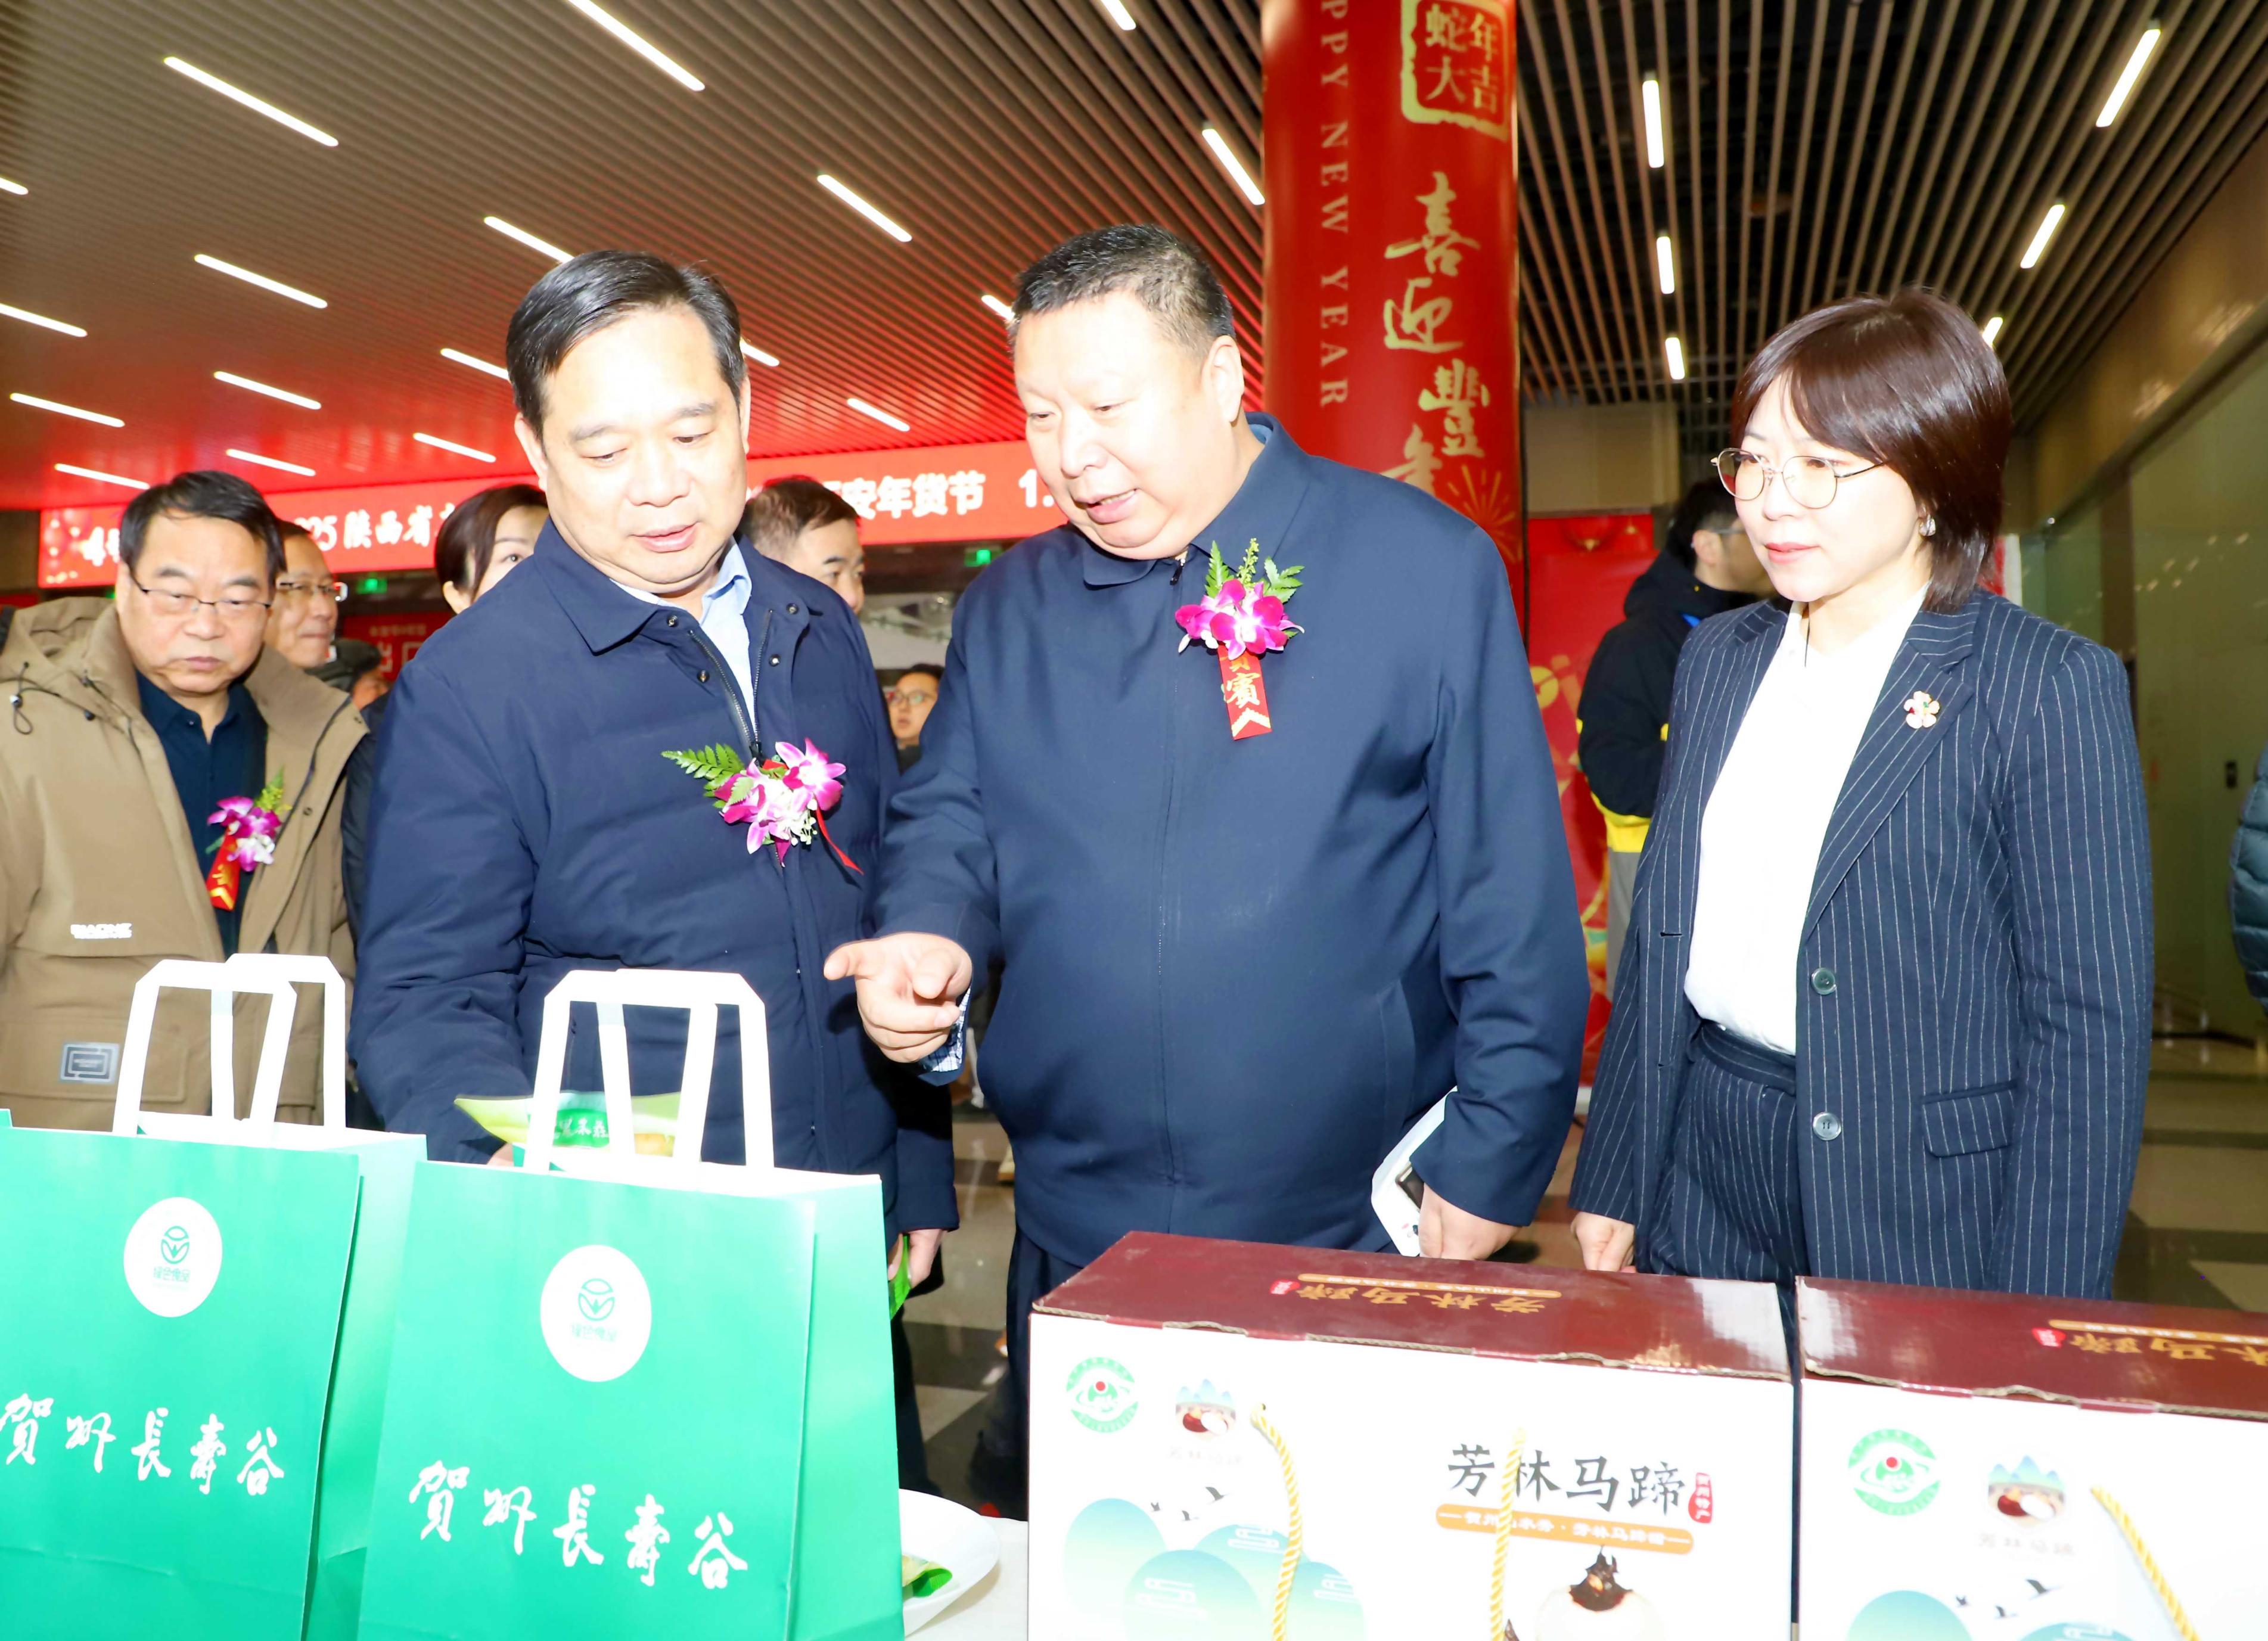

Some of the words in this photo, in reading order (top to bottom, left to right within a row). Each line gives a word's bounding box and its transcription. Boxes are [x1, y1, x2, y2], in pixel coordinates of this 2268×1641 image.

[1425, 3, 1499, 62] 蛇年
[1425, 56, 1497, 114] 大吉
[1321, 121, 1349, 234] NEW
[1321, 266, 1349, 407] YEAR
[1447, 1443, 1686, 1516] 芳林马蹄
